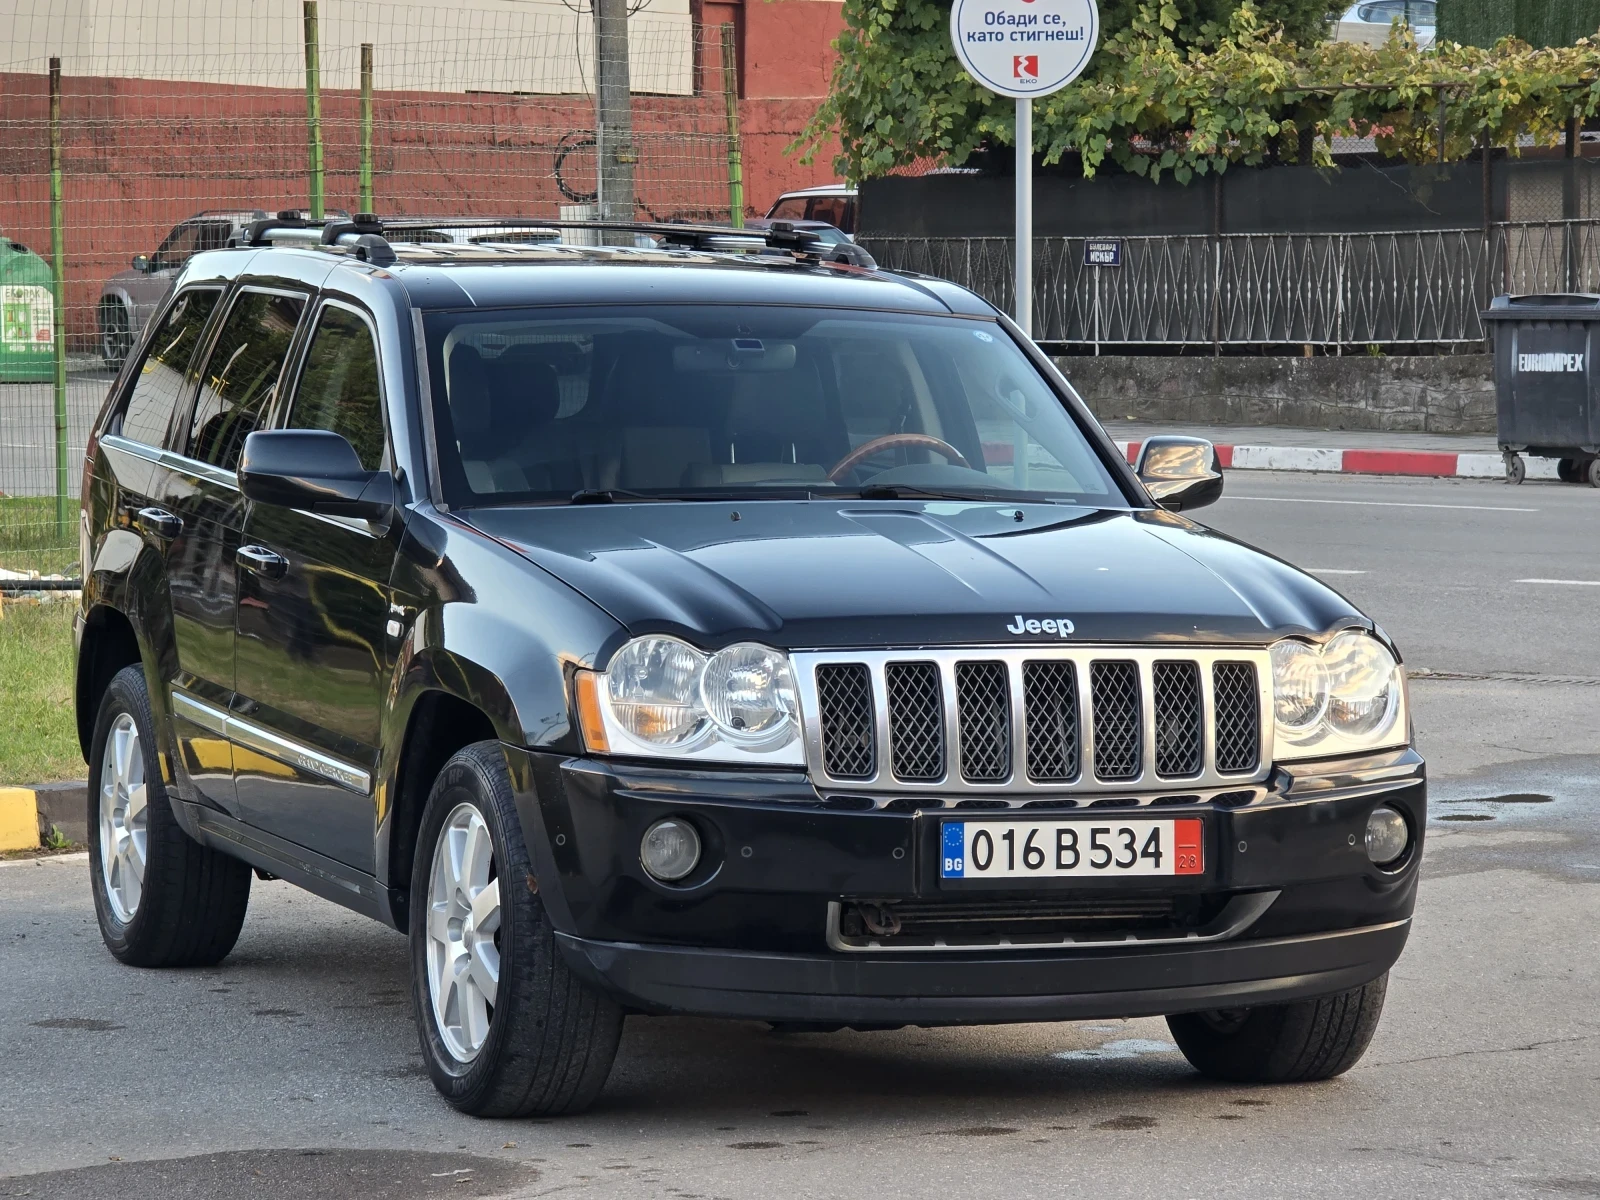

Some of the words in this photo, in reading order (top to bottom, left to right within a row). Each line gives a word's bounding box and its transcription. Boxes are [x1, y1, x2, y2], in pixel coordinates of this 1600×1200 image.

[984, 11, 1038, 27] Обади
[1043, 14, 1066, 27] се,
[967, 31, 1004, 42] като
[1010, 26, 1084, 42] стигнеш!
[1090, 251, 1115, 263] ИСКЪР
[1518, 353, 1584, 372] EUROIMPEX
[1006, 615, 1075, 638] Jeep
[944, 858, 963, 872] BG
[1178, 854, 1197, 868] 28
